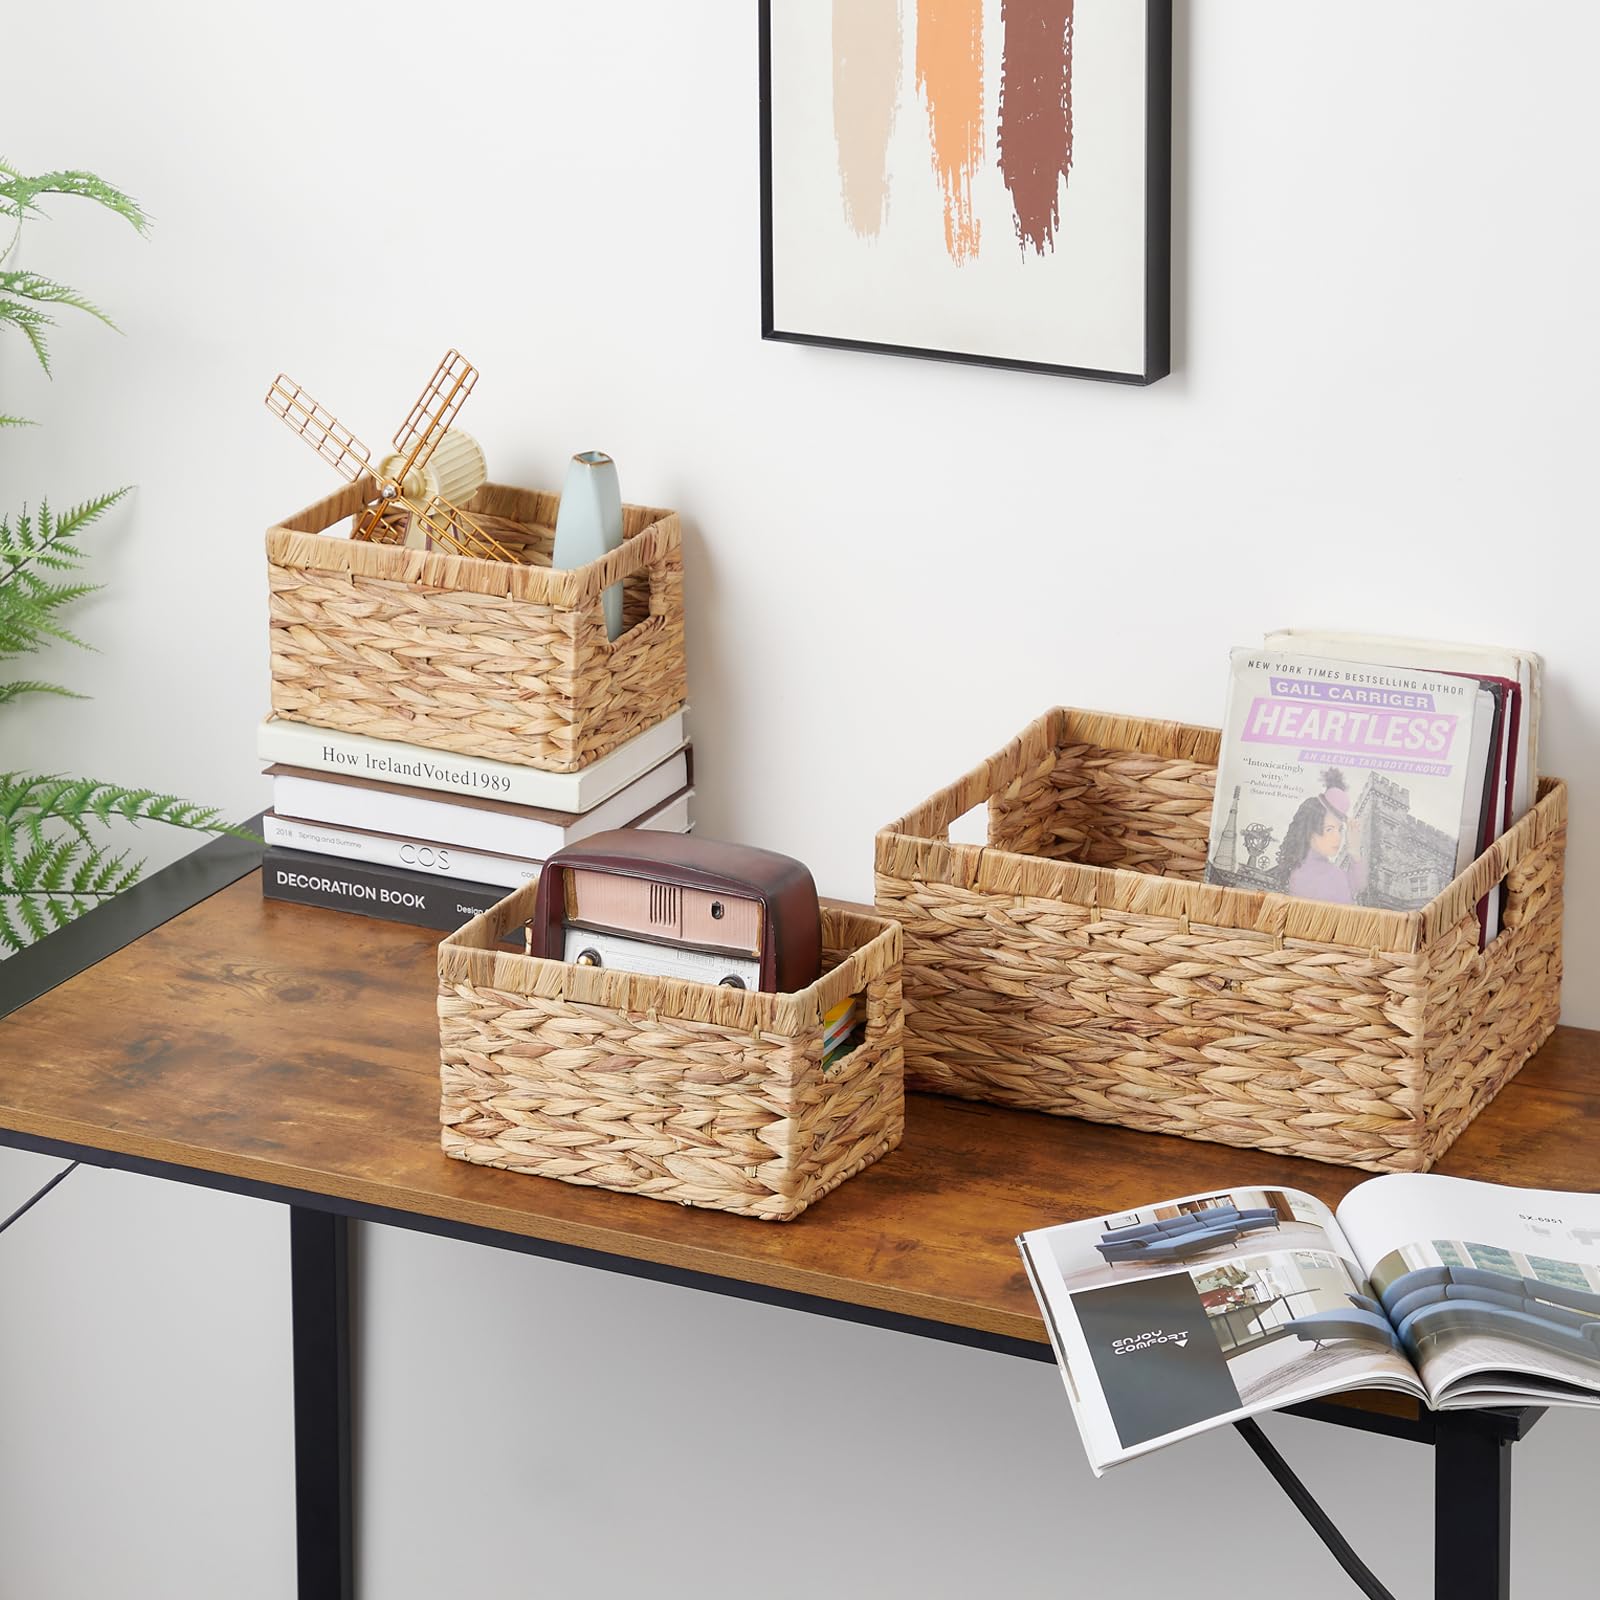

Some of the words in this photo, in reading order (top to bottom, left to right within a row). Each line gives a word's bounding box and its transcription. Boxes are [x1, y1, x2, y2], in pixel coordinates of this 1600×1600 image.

[1247, 660, 1270, 670] NEW
[1275, 664, 1302, 674] YORK
[1308, 668, 1340, 679] TIMES
[1345, 672, 1417, 689] BESTSELLING
[1422, 683, 1464, 695] AUTHOR
[1275, 681, 1321, 696] GAIL
[1328, 687, 1429, 708] CARRIGER
[1252, 703, 1450, 752] HEARTLESS
[323, 746, 359, 766] How
[1415, 765, 1447, 775] NOVEL
[299, 832, 320, 842] Spring
[399, 844, 450, 870] COS
[521, 871, 535, 880] COS
[276, 870, 377, 901] DECORATION
[380, 888, 426, 910] BOOK
[1112, 1330, 1162, 1348] ENJOY
[1115, 1331, 1189, 1355] COMFORT
